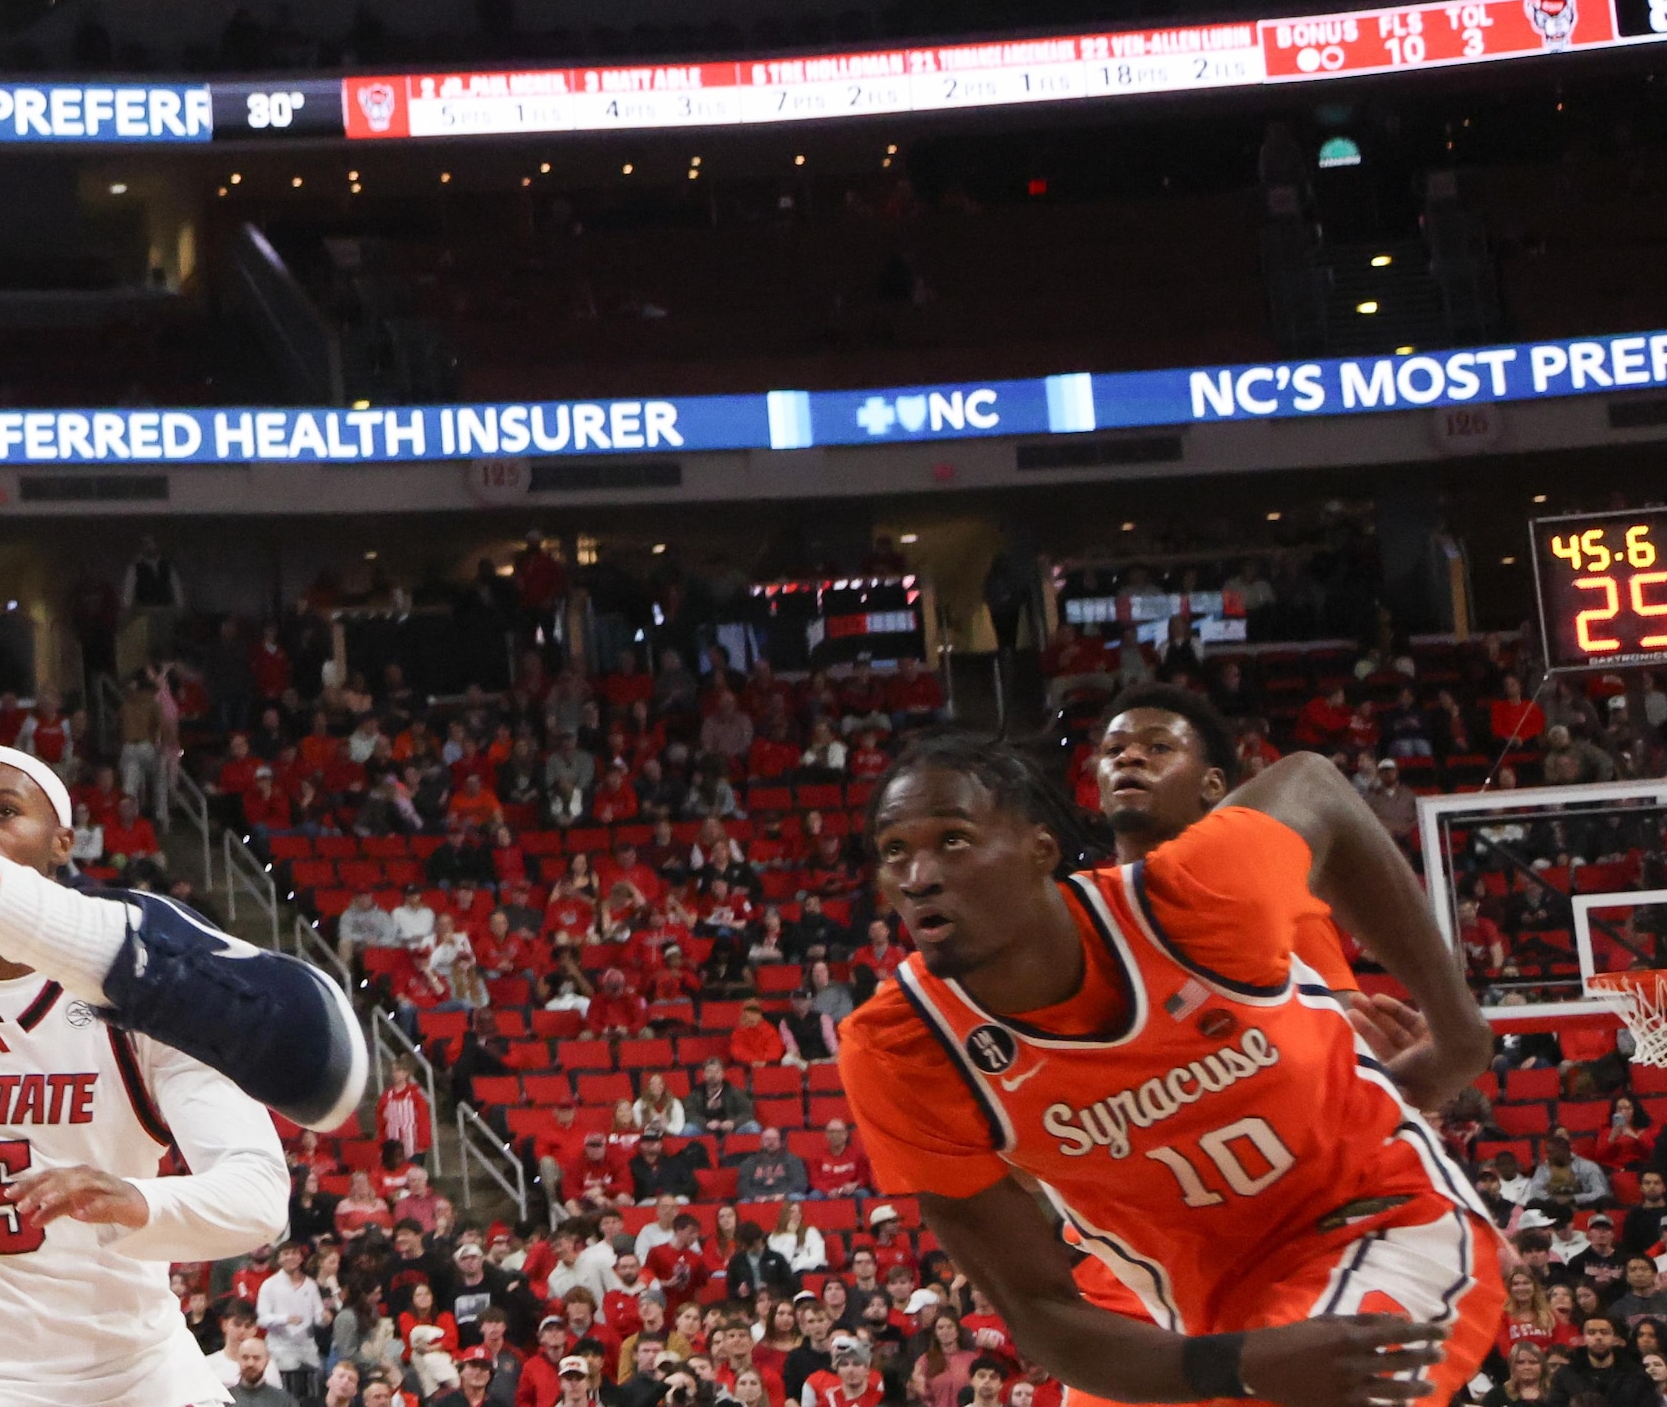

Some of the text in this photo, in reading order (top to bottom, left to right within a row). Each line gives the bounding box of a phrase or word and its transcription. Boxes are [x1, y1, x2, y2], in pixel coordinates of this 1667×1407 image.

[1276, 4, 1494, 48] BONUS FLS TOL
[1081, 38, 1109, 60] 22
[1384, 29, 1485, 65] 10 3
[909, 51, 936, 73] 21
[1099, 64, 1132, 86] 18
[1192, 58, 1209, 80] 2
[774, 91, 788, 112] 7
[847, 86, 863, 106] 2
[942, 78, 958, 99] 2
[1020, 73, 1031, 93] 1
[442, 105, 456, 125] 5
[516, 104, 525, 123] 1
[605, 100, 620, 118] 4
[677, 96, 692, 117] 3
[215, 403, 425, 458] HEALTH
[441, 402, 684, 454] INSURER
[929, 385, 1000, 431] NC
[1340, 349, 1516, 408] MOST
[1551, 525, 1656, 572] 45.6
[1043, 1025, 1280, 1161] Syracuse
[1146, 1116, 1297, 1209] 10
